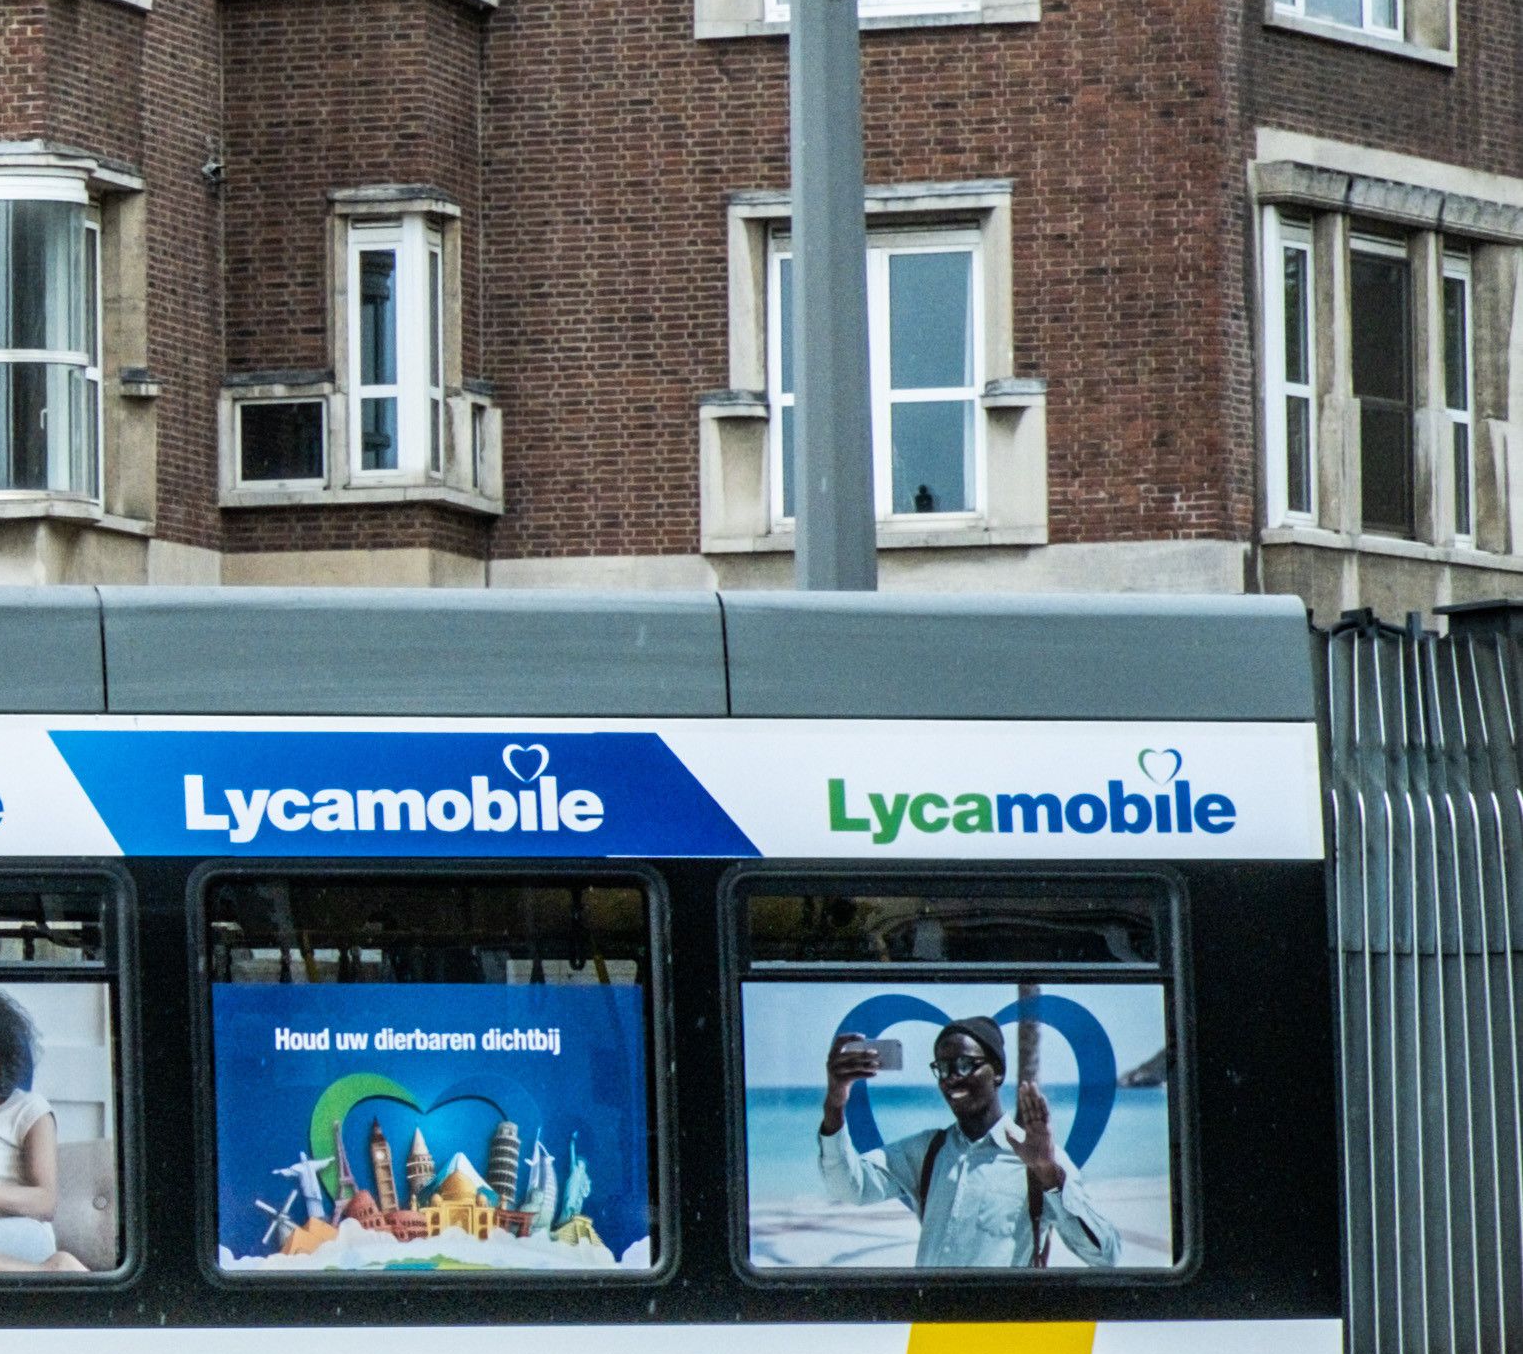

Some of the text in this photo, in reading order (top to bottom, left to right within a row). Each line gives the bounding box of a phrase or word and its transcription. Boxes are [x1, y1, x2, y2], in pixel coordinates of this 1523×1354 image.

[183, 773, 606, 845] Lycamobile
[828, 777, 1238, 845] Lycamobile
[274, 1027, 562, 1057] Houd uw dierbaren dichtbij
